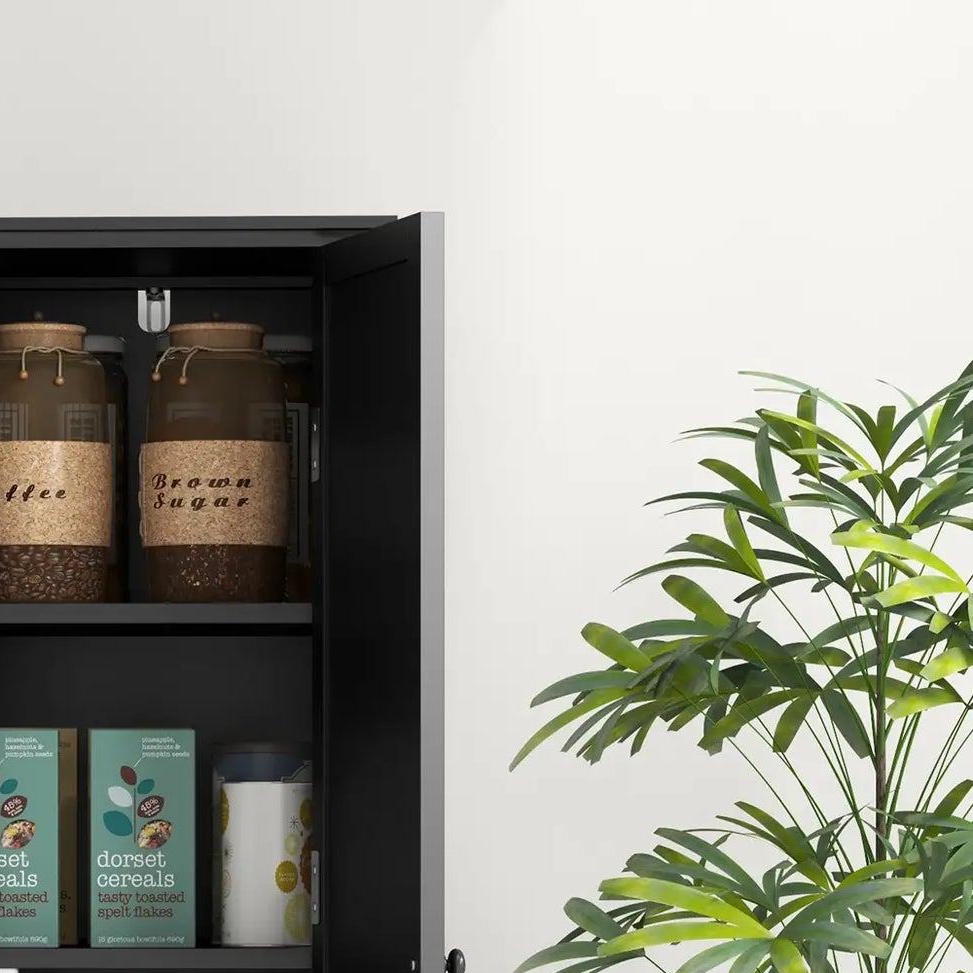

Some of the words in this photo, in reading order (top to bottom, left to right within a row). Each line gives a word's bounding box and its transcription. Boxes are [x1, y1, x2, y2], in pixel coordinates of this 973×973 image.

[152, 473, 254, 489] Brown
[153, 493, 249, 511] Sugar
[97, 850, 166, 868] dorset
[97, 870, 175, 888] cereals
[0, 891, 49, 903] toasted
[98, 891, 132, 905] tasty
[136, 891, 186, 903] toasted
[98, 906, 131, 919] spelt
[134, 906, 174, 918] flakes
